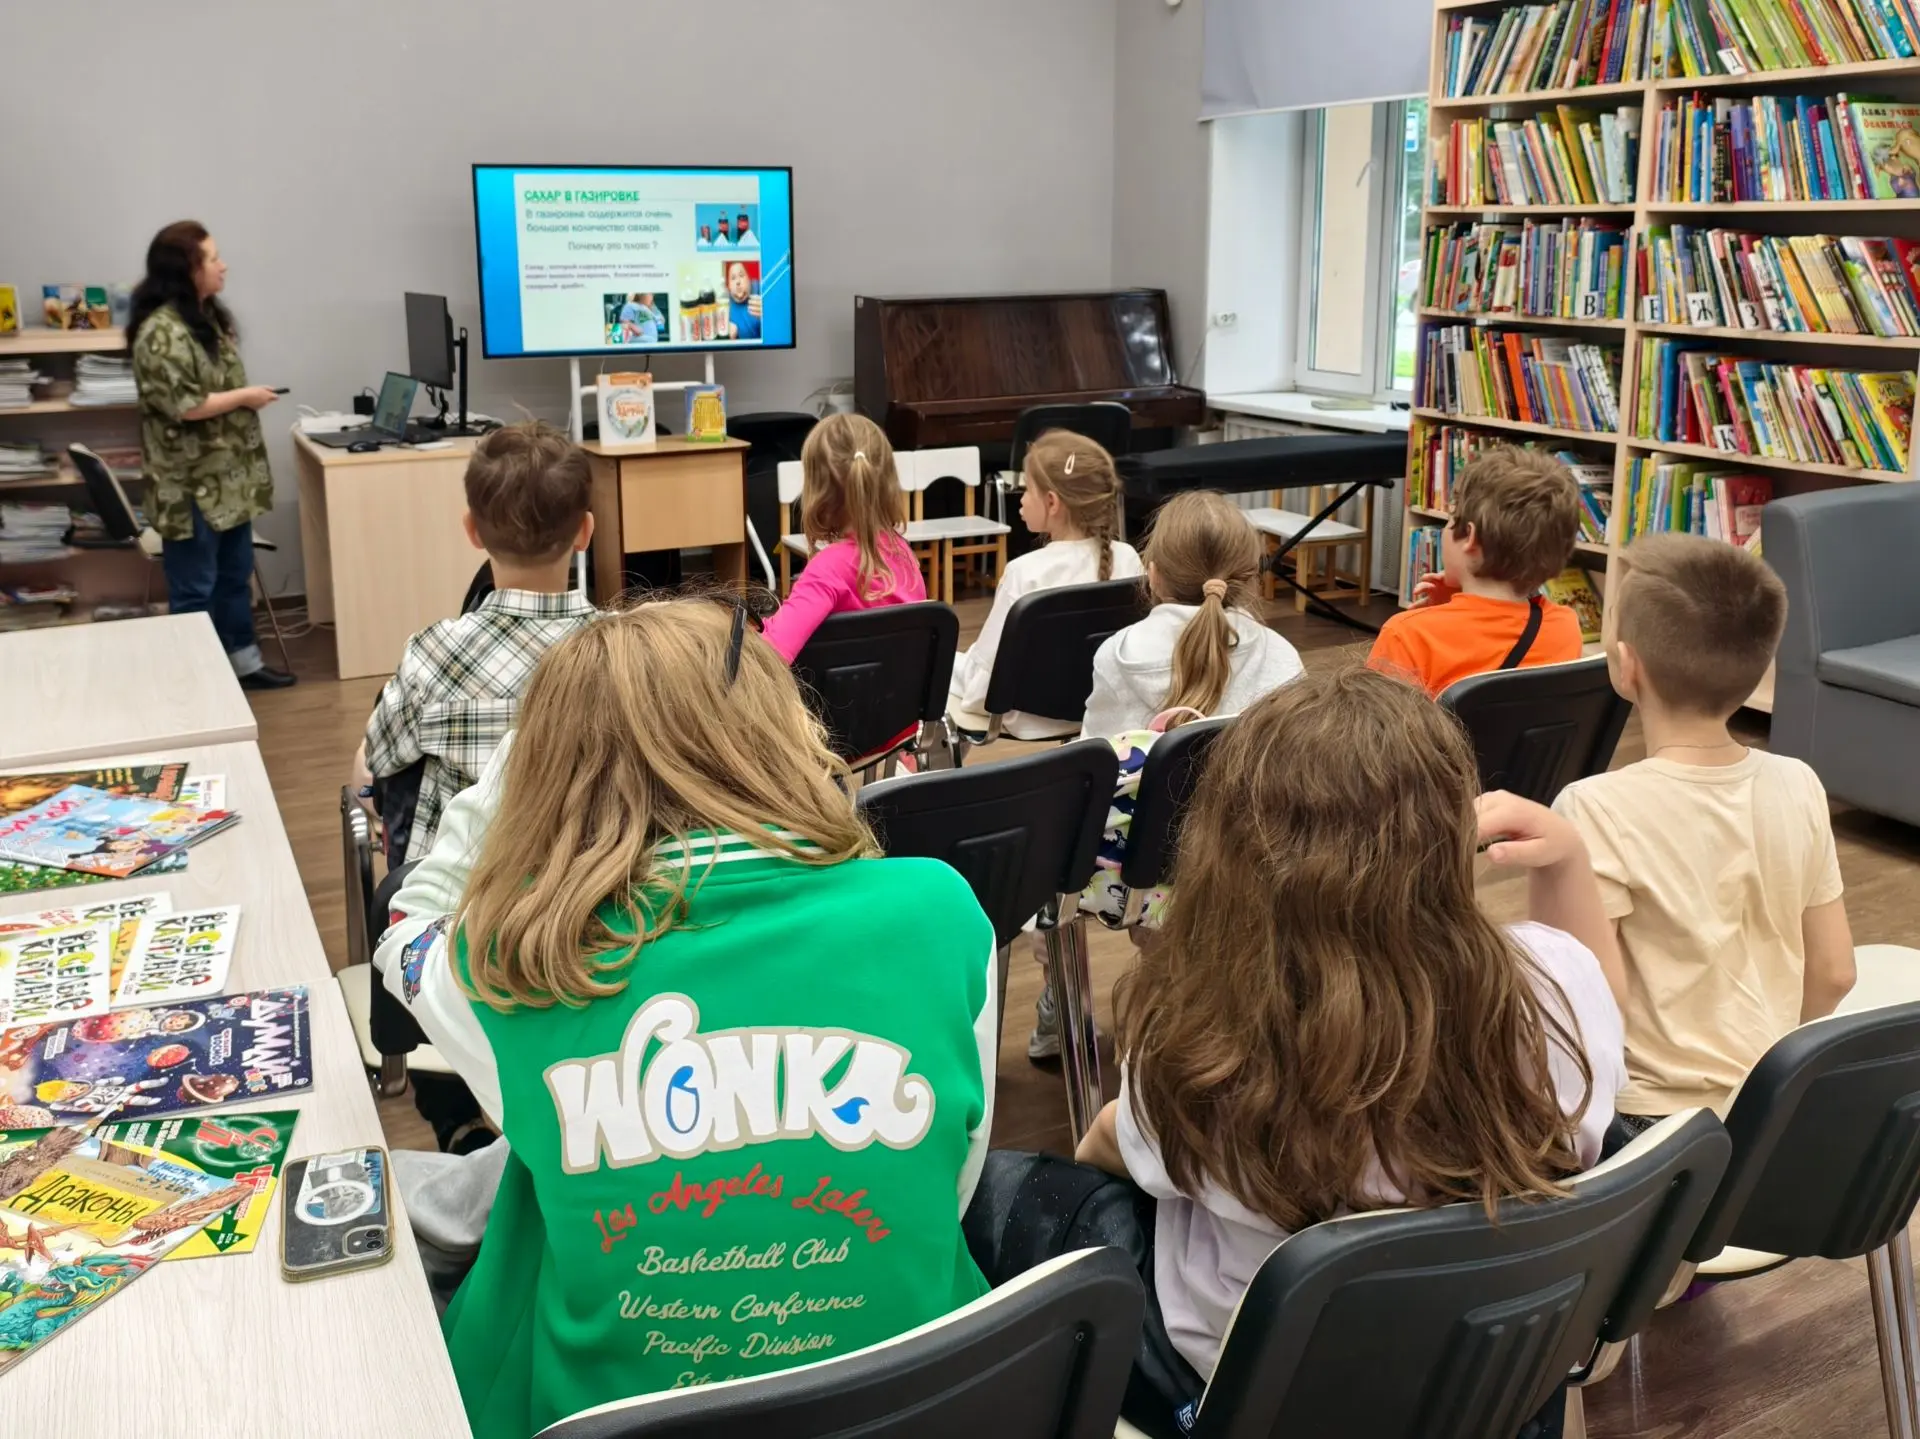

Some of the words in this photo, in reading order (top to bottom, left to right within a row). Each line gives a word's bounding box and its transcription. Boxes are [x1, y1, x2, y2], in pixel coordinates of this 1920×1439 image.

[524, 190, 562, 202] САХАР
[564, 190, 573, 202] В
[575, 190, 640, 202] ГАЗИРОВКЕ
[526, 209, 533, 219] В
[536, 210, 585, 220] газировке
[588, 210, 643, 220] содержится
[526, 223, 569, 233] большое
[572, 224, 626, 233] количество
[568, 241, 604, 251] Почему
[606, 243, 622, 251] это
[624, 243, 650, 251] плохо
[1584, 295, 1596, 316] В
[1692, 298, 1713, 321] Ж
[1720, 428, 1737, 450] К
[241, 998, 300, 1077] ДУМАЙ
[8, 1174, 148, 1225] Драконы
[592, 1203, 637, 1253] Los
[648, 1162, 784, 1219] Angeles
[792, 1176, 892, 1243] Lakers
[637, 1241, 787, 1276] Basketball
[792, 1237, 851, 1270] Club
[618, 1290, 722, 1320] Western
[730, 1292, 867, 1326] Conference
[642, 1330, 732, 1364] Pacific
[739, 1332, 836, 1359] Division
